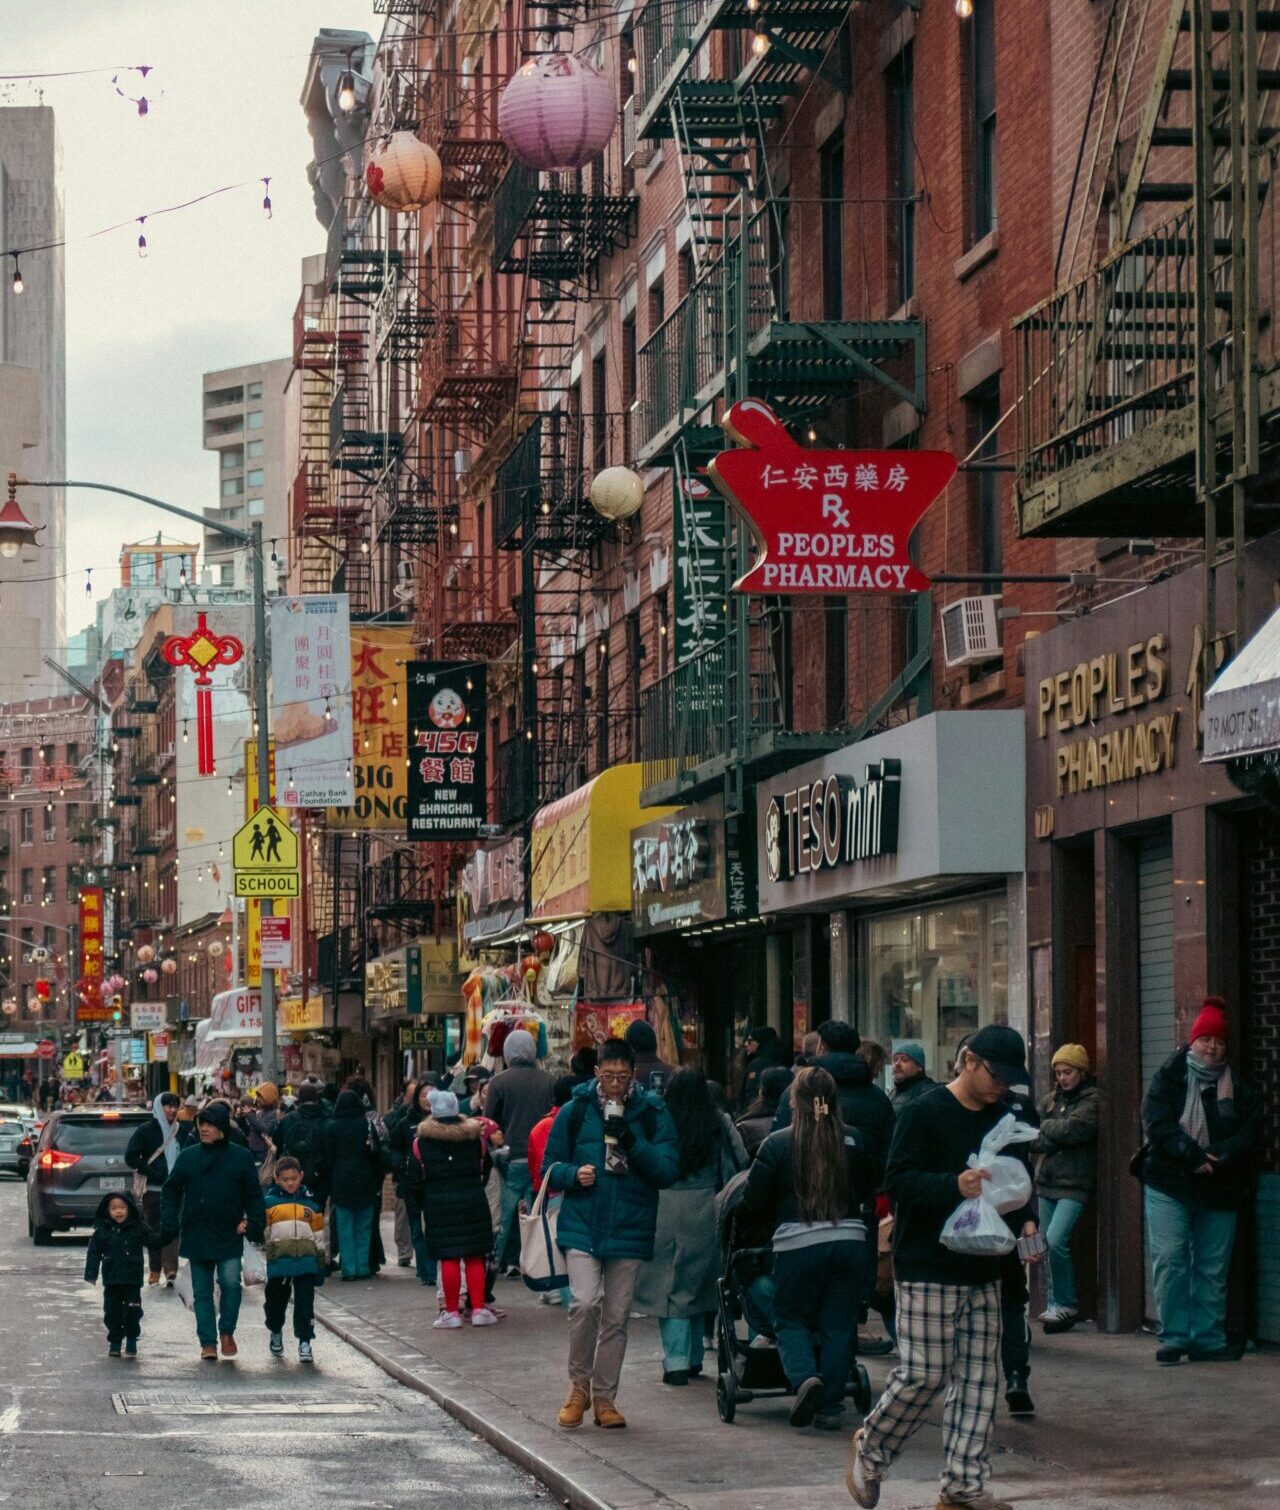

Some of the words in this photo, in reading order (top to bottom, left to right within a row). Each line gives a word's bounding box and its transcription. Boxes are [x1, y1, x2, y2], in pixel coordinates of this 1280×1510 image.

[760, 463, 910, 492] 仁安西藥房
[777, 533, 895, 558] PEOPLES
[763, 563, 910, 588] PHARMACY
[1038, 632, 1168, 739] PEOPLES
[1221, 710, 1247, 735] MOTT
[416, 731, 479, 754] 456
[1056, 711, 1180, 798] PHARMACY
[420, 757, 474, 783] 餐館
[300, 791, 326, 801] Cathay
[328, 789, 347, 797] Bank
[300, 798, 342, 806] Foundation
[434, 790, 457, 801] NEW
[419, 803, 473, 815] SHANGHAI
[784, 774, 842, 876] TESO
[845, 758, 892, 862] mini
[412, 817, 482, 830] RESTAURANT
[239, 878, 295, 892] SCHOOL
